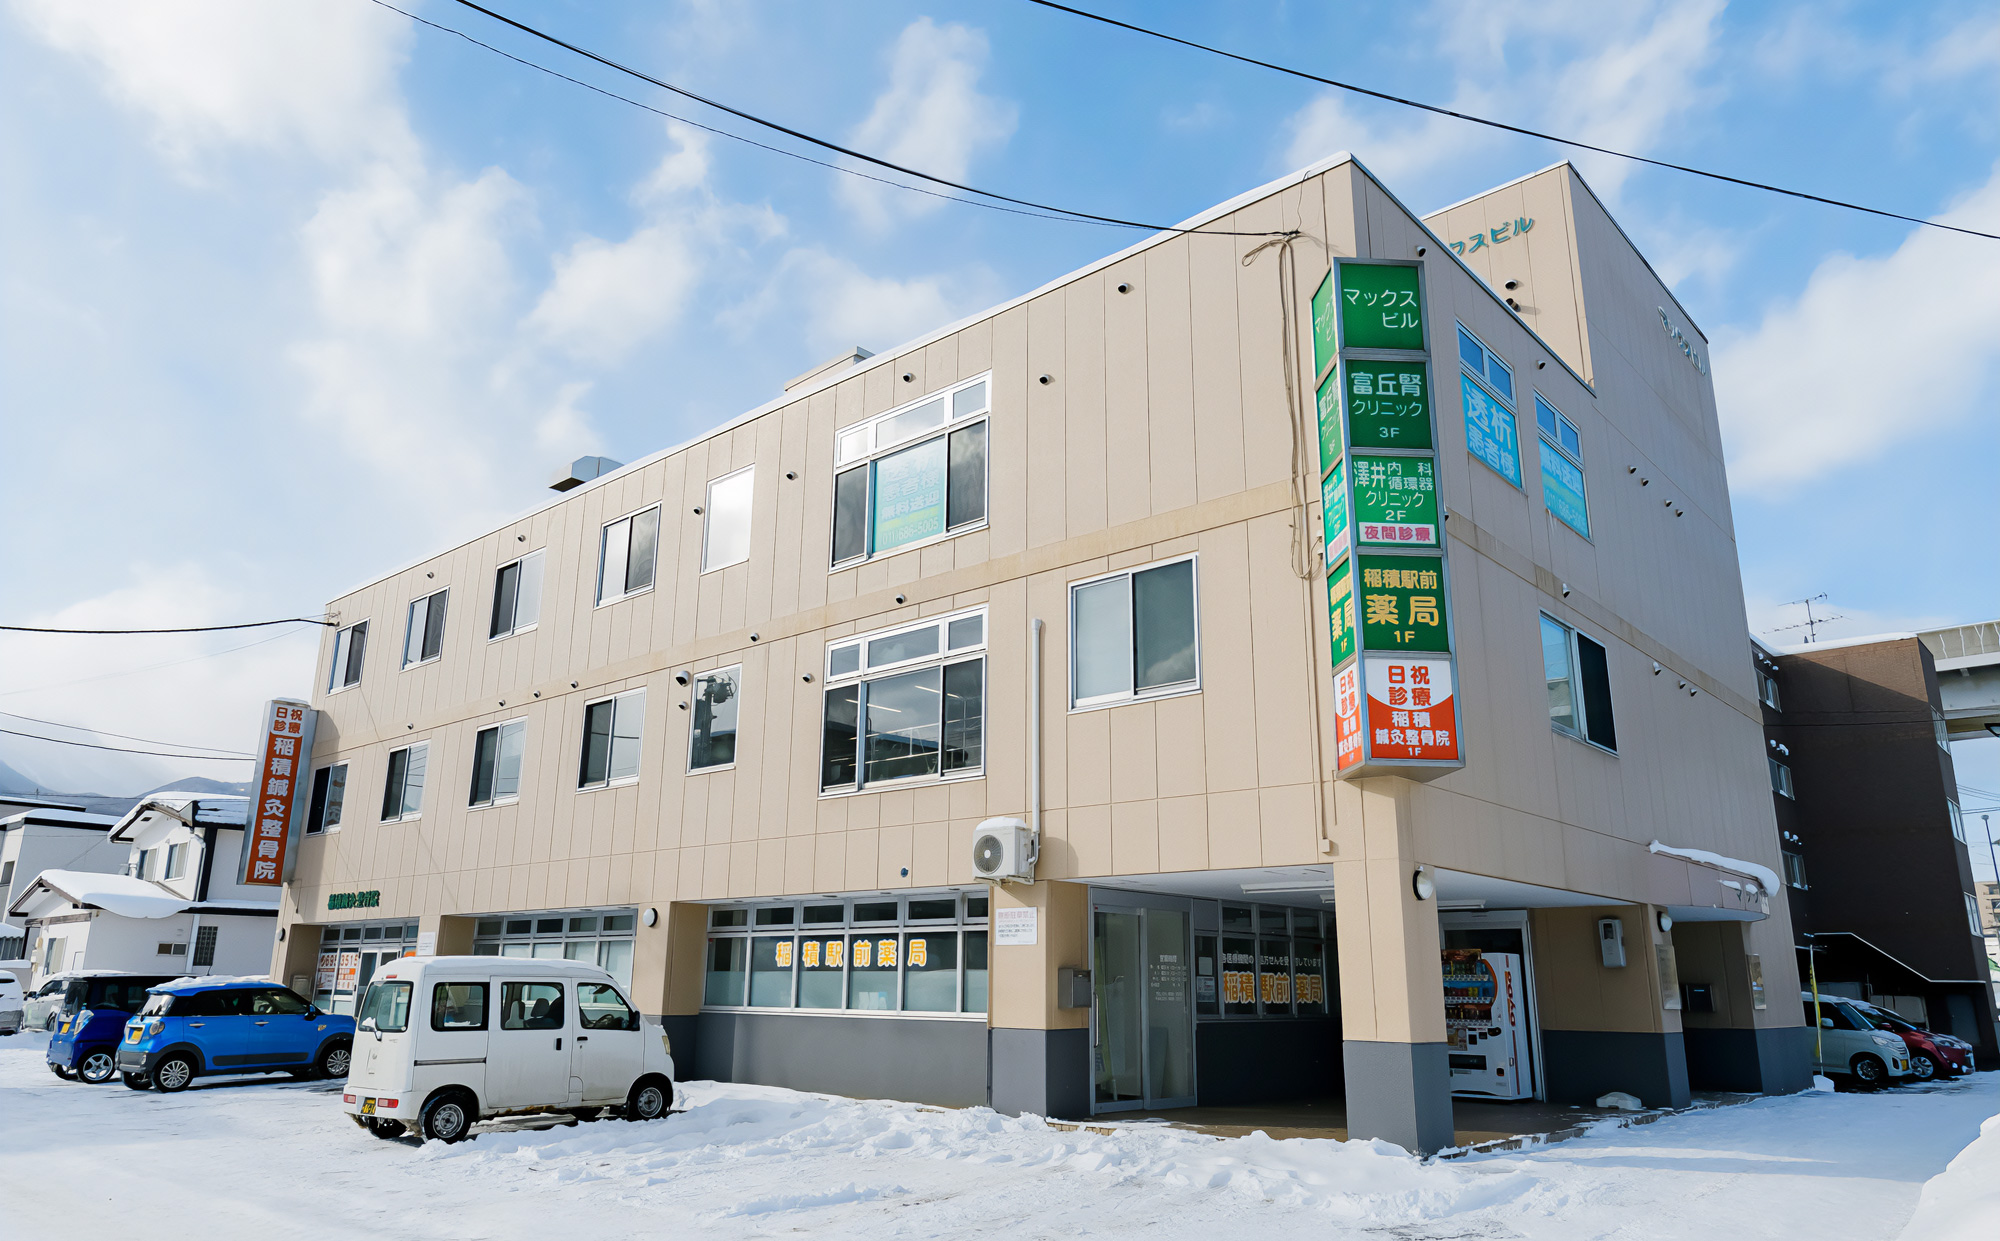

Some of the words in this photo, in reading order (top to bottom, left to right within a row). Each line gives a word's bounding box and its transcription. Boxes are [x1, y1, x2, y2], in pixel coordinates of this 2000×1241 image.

[1343, 288, 1417, 307] マックス
[1382, 312, 1419, 329] ビル
[1350, 371, 1422, 397] 富丘腎
[1352, 399, 1423, 417] クリニック
[1465, 382, 1512, 450] 透析
[1379, 426, 1400, 438] 3F
[1468, 422, 1516, 481] 患者様
[1353, 461, 1386, 488] 澤井
[1387, 461, 1433, 476] 内科
[1388, 477, 1434, 492] 循環器
[1365, 491, 1424, 508] クリニック
[1385, 509, 1407, 521] 2F
[1364, 525, 1431, 542] 夜間診療
[1363, 568, 1438, 590] 稲積駅前
[1365, 593, 1440, 627] 薬局
[1393, 630, 1416, 643] 1F
[1388, 664, 1430, 685] 日祝
[1388, 687, 1431, 707] 診療
[275, 706, 303, 721] 日祝
[1391, 711, 1431, 728] 稲積
[273, 719, 302, 734] 診療
[1374, 728, 1451, 747] 鍼灸整骨院
[1407, 747, 1422, 757] 1F
[253, 736, 296, 880] 稲積鍼灸整骨院
[340, 954, 359, 967] 3515
[775, 938, 928, 968] 稲積駅前薬局
[1222, 970, 1323, 1004] 稲積駅前薬局
